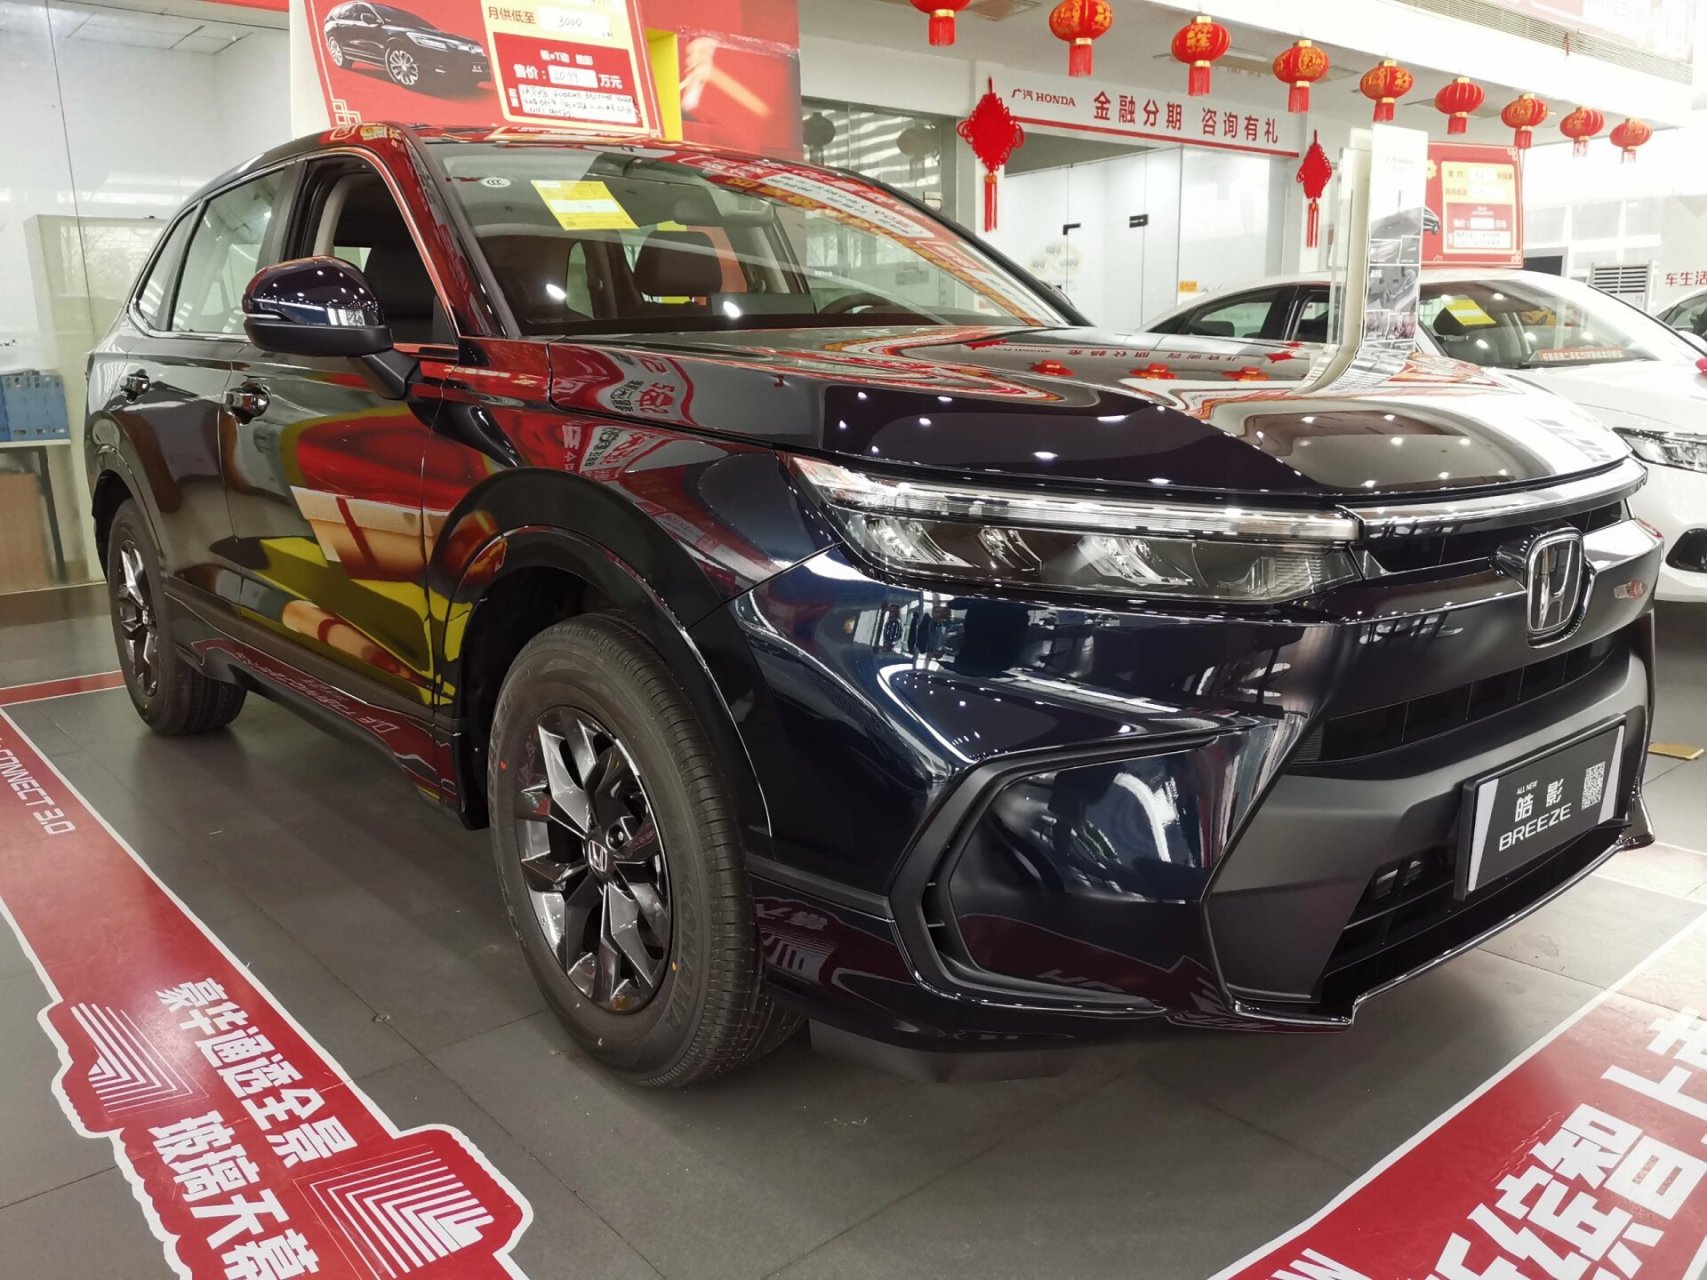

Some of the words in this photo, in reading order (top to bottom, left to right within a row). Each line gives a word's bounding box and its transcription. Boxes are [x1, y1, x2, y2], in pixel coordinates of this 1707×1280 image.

[488, 6, 536, 25] 月供低至
[598, 74, 623, 90] 万元
[1011, 88, 1034, 101] 广汽
[1035, 92, 1076, 107] HONDA
[1093, 91, 1183, 131] 金融分期
[1201, 107, 1280, 144] 咨询有礼
[1664, 271, 1707, 288] 车生活
[1514, 778, 1564, 823] 皓影
[1516, 784, 1526, 795] ALL
[1526, 779, 1539, 792] NEW
[32, 808, 76, 835] 3.0
[1499, 802, 1572, 851] BREEZE
[155, 977, 358, 1169] 豪华通透全景
